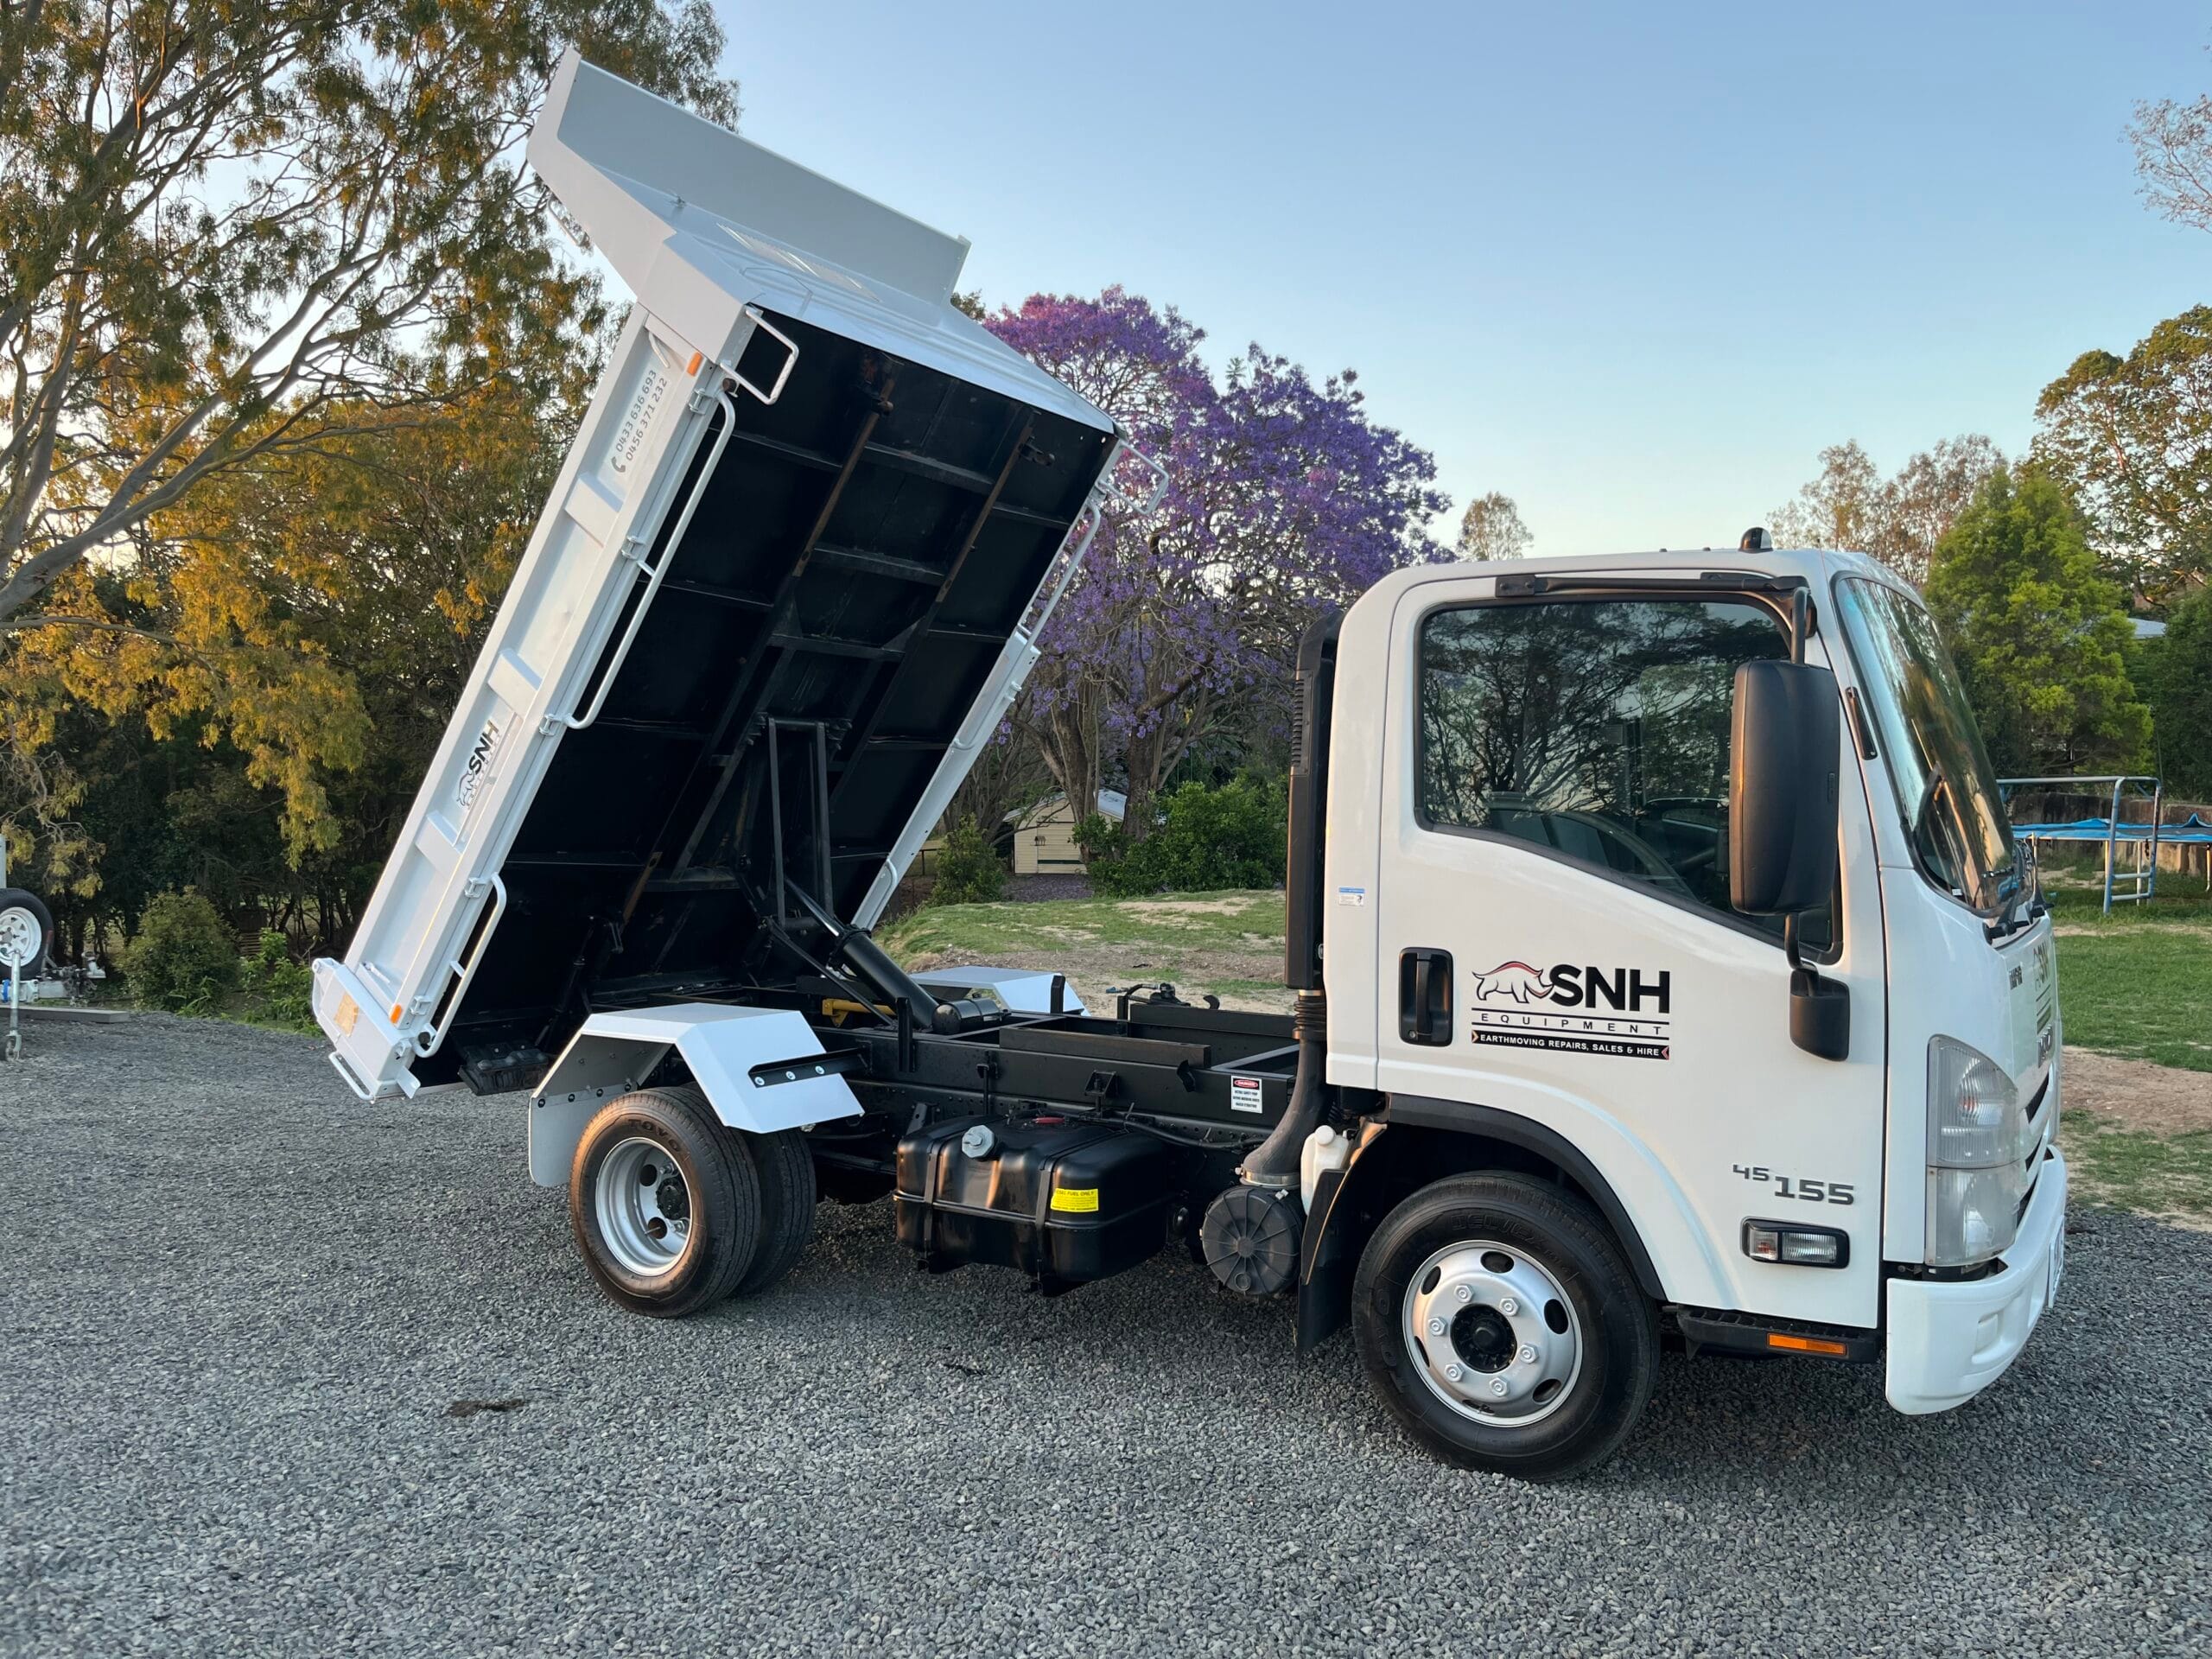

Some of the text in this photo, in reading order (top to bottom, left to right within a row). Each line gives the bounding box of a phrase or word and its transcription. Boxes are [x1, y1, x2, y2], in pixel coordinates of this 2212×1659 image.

[615, 369, 657, 453] 0433 636 693
[626, 378, 667, 461] 0456 371 232
[468, 719, 499, 775] SNH
[1549, 963, 1670, 1014] SNH
[1480, 1033, 1660, 1056] EARTHMOVING REPAIRS, SALES & HIRE
[1481, 1013, 1662, 1035] EQUIPMENT
[627, 1118, 681, 1153] TOYO
[1732, 1164, 1854, 1205] 45 155
